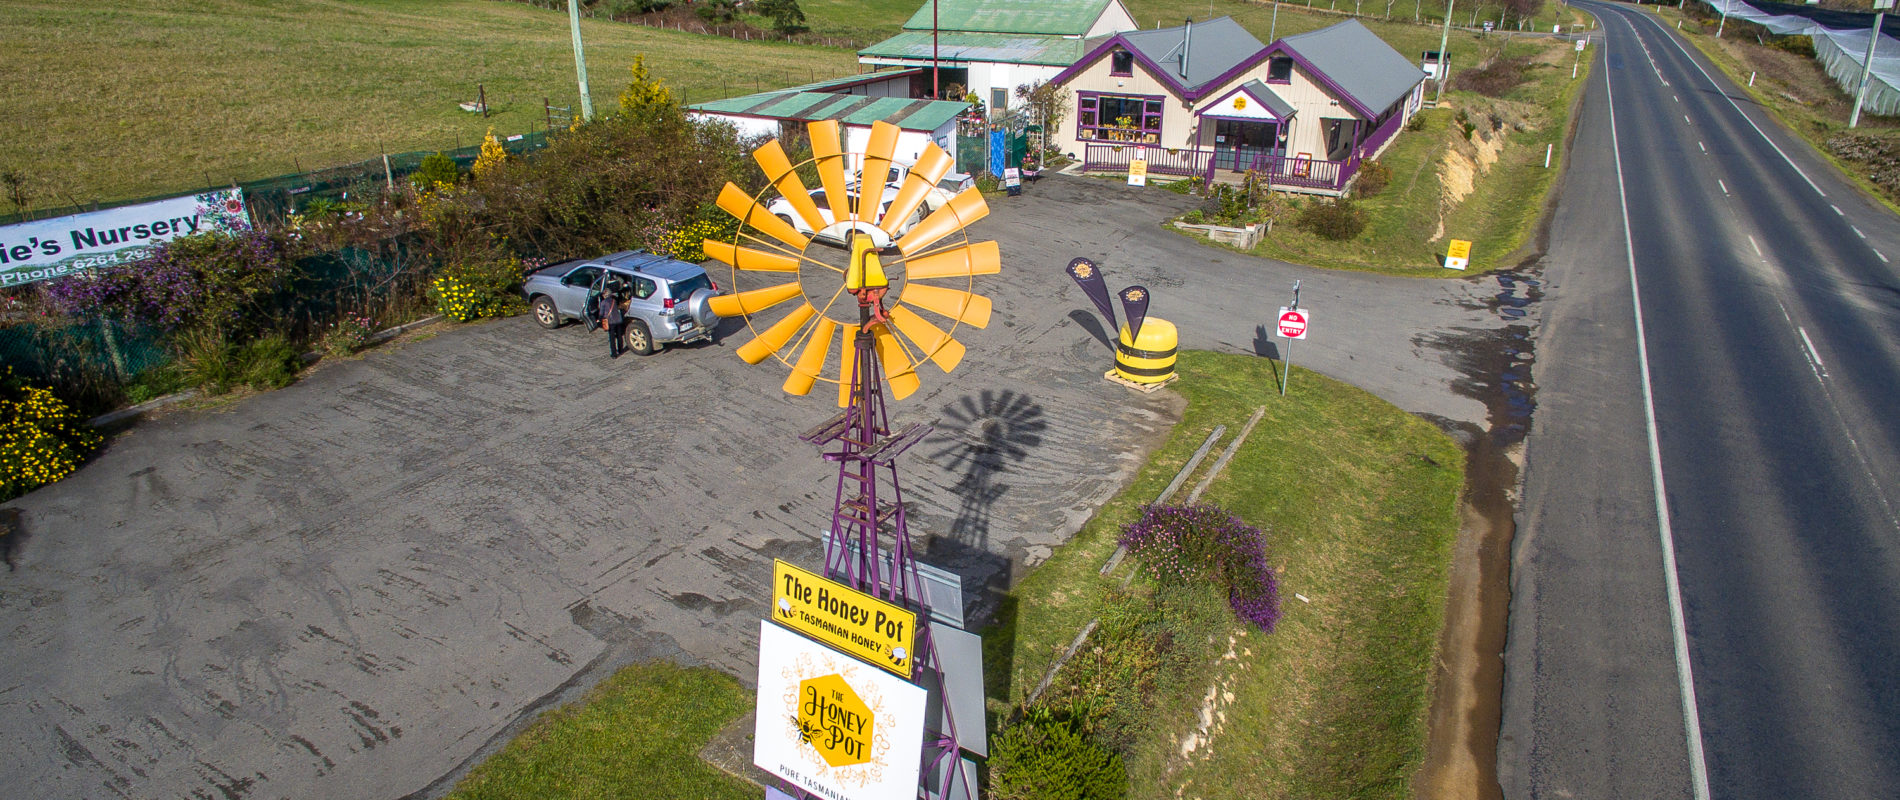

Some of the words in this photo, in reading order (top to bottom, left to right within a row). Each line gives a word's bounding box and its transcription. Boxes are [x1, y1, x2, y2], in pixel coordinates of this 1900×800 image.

[69, 214, 200, 251] Nursery
[1, 265, 68, 285] Phone
[73, 253, 118, 269] 6264
[783, 573, 812, 605] The
[817, 587, 870, 627] Honey
[874, 610, 904, 643] Pot
[799, 610, 849, 640] TASMANIAN
[851, 632, 882, 654] HONEY
[831, 688, 845, 704] THE
[779, 763, 800, 782] PURE
